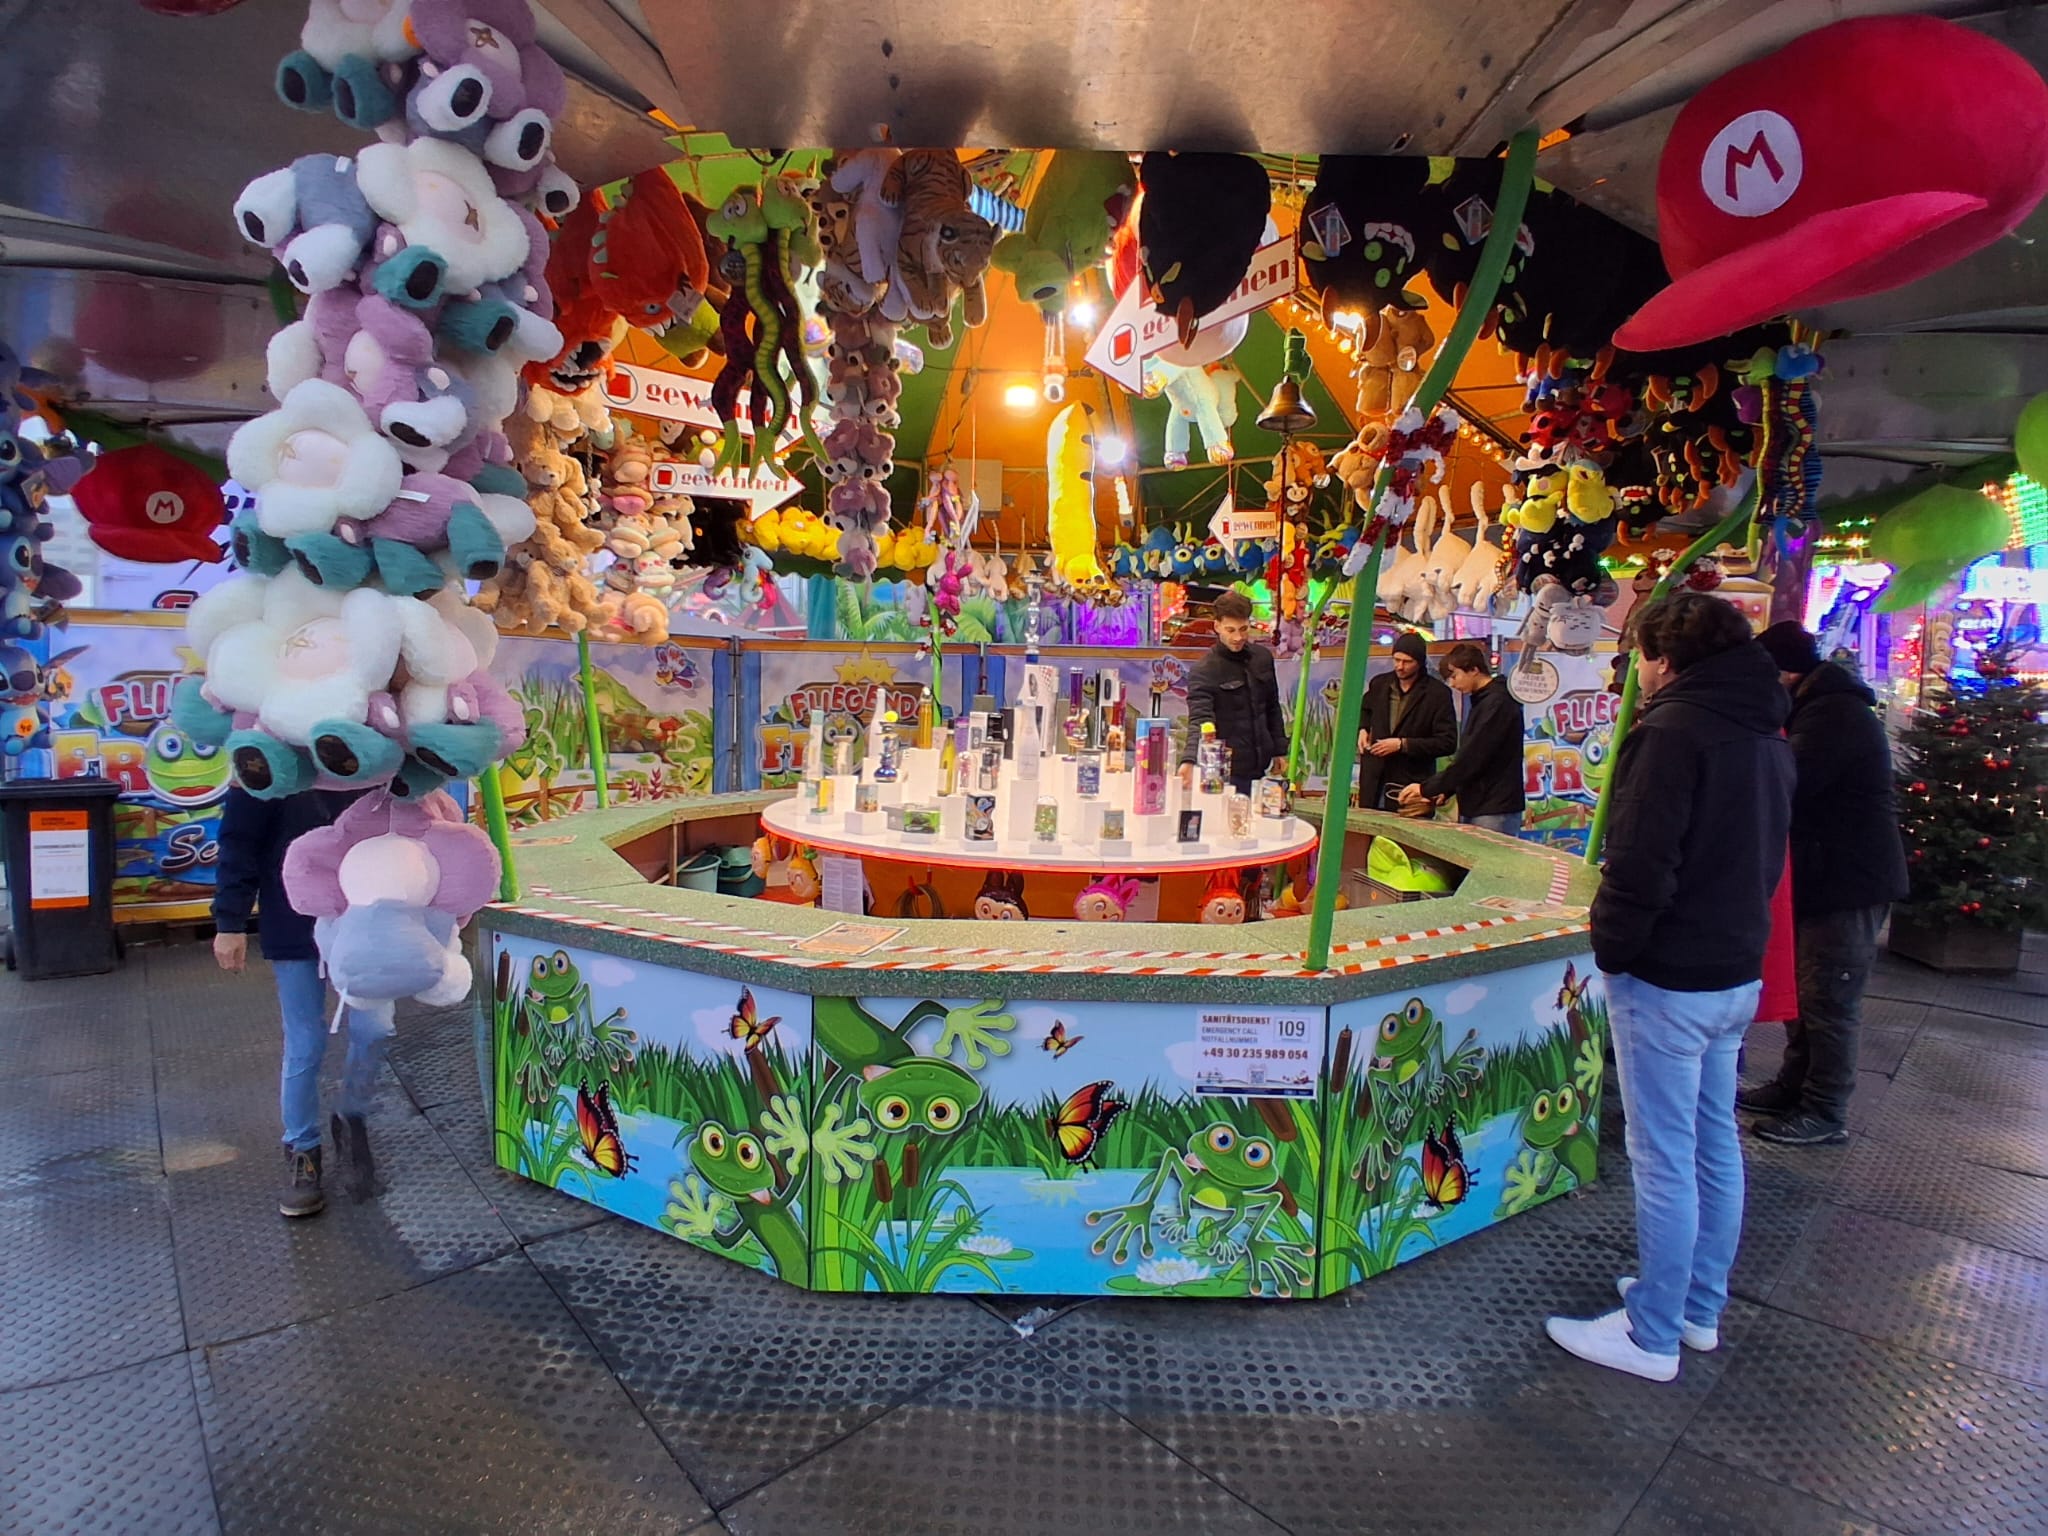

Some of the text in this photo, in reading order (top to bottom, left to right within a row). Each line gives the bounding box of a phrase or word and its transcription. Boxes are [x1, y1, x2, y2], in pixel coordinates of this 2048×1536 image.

[1725, 129, 1785, 201] M
[153, 497, 177, 517] M
[1202, 1014, 1271, 1025] SANITÄTSDIENST
[1201, 1026, 1241, 1034] EMERGENCY
[1278, 1021, 1305, 1037] 109
[1203, 1047, 1308, 1060] +49 30 235 989 054
